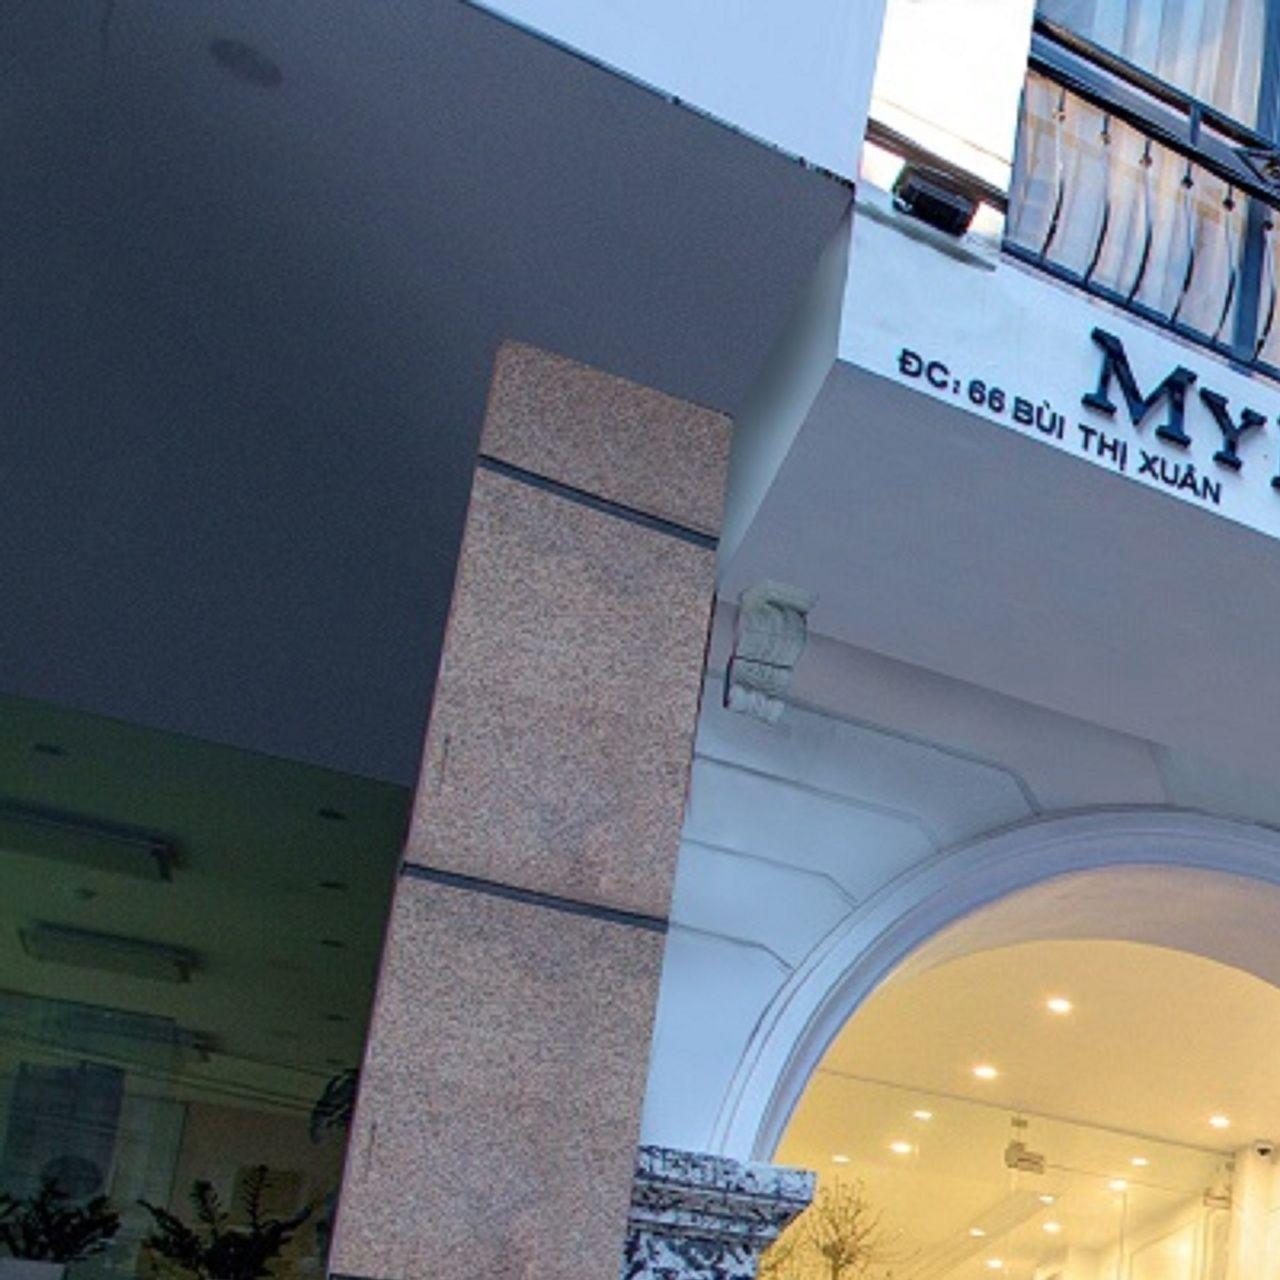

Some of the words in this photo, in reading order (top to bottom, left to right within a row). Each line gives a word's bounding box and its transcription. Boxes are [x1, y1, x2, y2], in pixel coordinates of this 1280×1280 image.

[967, 379, 1006, 414] 66
[1011, 397, 1066, 440] BÙI
[1078, 422, 1128, 471] THỊ
[1138, 449, 1221, 505] XUÂN
